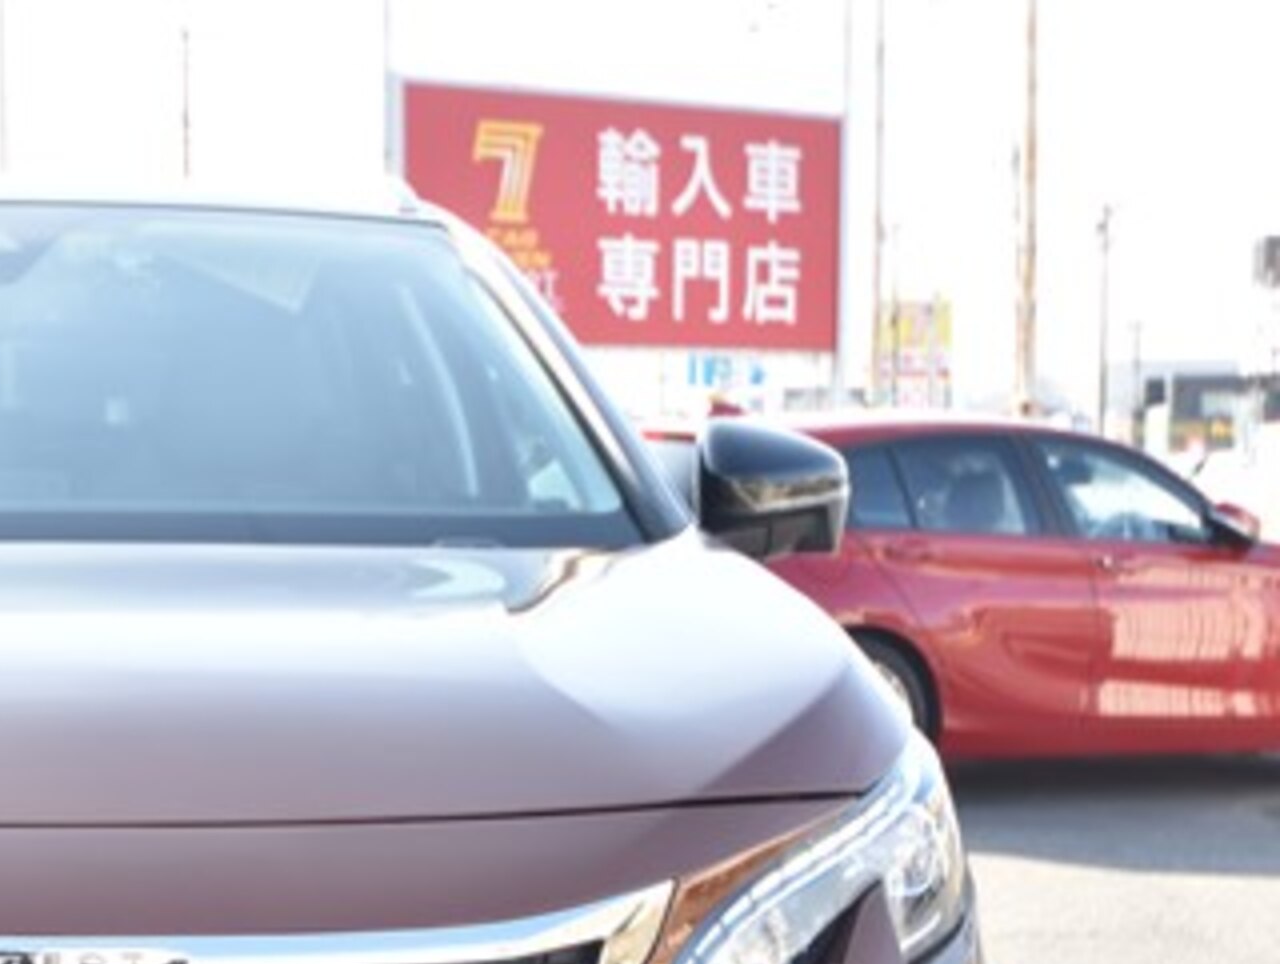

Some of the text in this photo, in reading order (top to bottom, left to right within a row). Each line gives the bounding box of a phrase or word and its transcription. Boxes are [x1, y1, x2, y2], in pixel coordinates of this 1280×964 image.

[596, 127, 802, 222] 輸入車
[596, 233, 801, 325] 専門店
